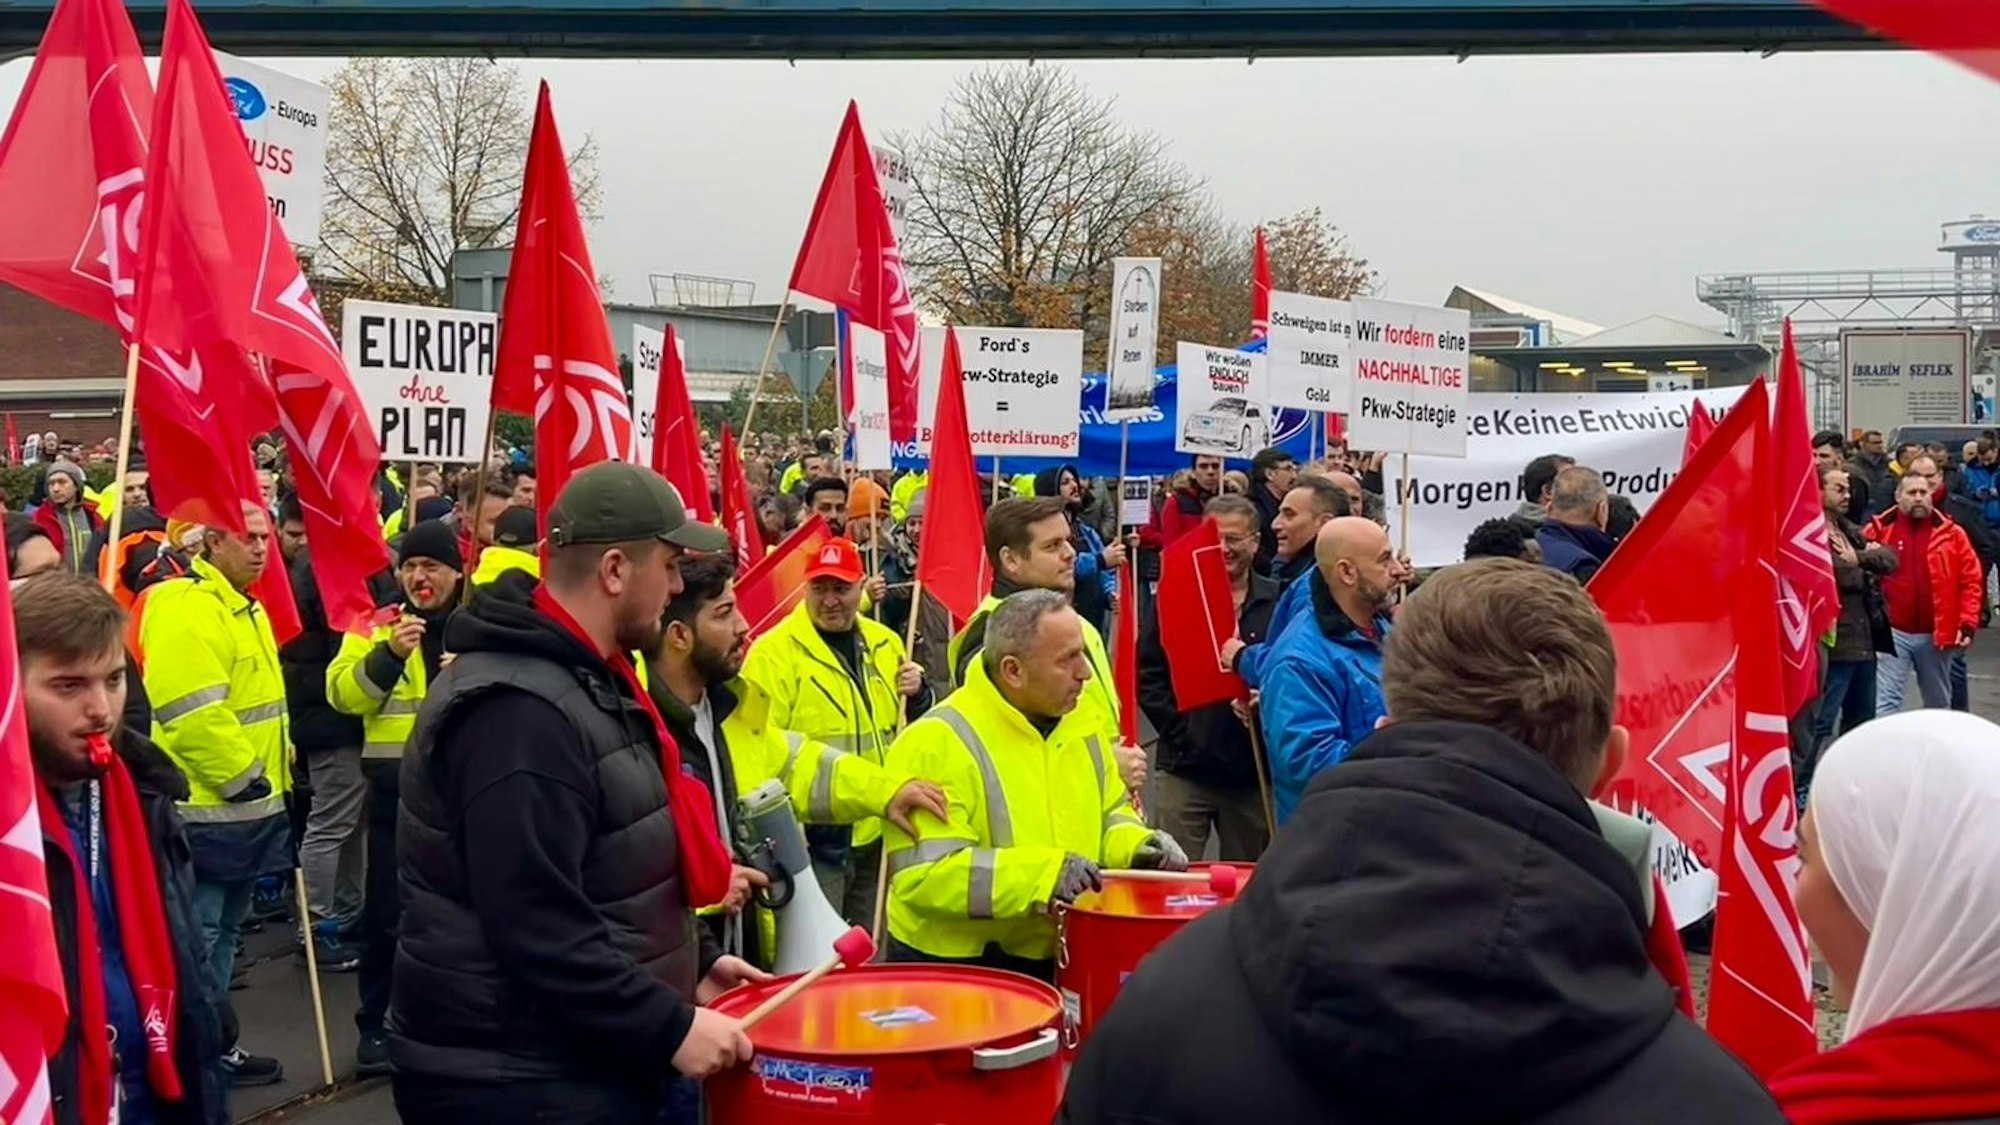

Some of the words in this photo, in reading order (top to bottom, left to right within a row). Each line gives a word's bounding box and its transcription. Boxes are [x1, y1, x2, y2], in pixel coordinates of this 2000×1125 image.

[278, 101, 317, 127] Europa
[246, 138, 293, 174] USS
[1271, 312, 1327, 333] Schweigen
[1329, 320, 1342, 333] ist
[1357, 320, 1382, 342] Wir
[1384, 323, 1435, 348] fordern
[1438, 331, 1465, 351] eine
[360, 316, 494, 375] EUROPA
[1205, 350, 1221, 363] Wir
[1222, 353, 1252, 368] wollen
[1300, 350, 1340, 368] IMMER
[1209, 366, 1249, 383] ENDLICH
[1358, 358, 1461, 388] NACHHALTIGE
[400, 374, 450, 403] ohne
[1306, 387, 1330, 403] Gold
[1362, 397, 1456, 428] Pkw-Strategie
[1494, 408, 1578, 436] Keine
[381, 407, 466, 456] PLAN
[921, 428, 1077, 449] Botterklärung?
[1395, 477, 1511, 510] Morgen
